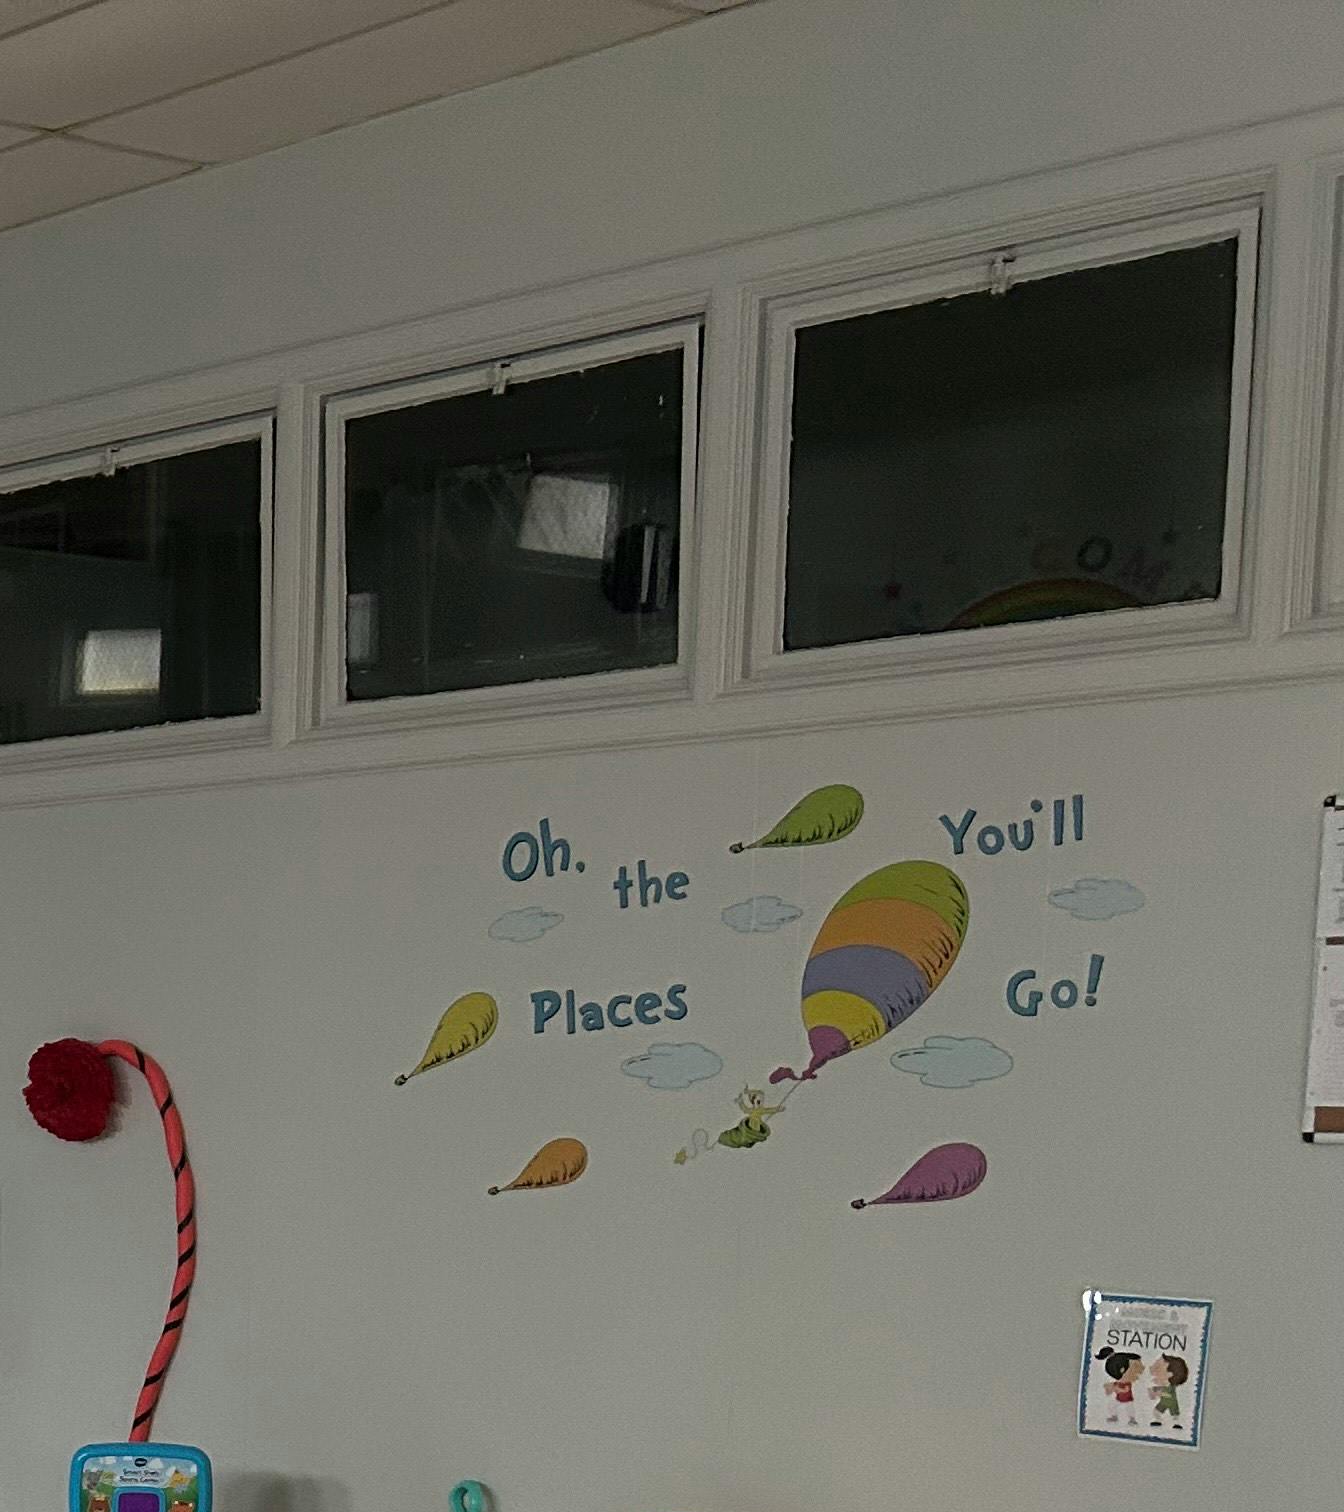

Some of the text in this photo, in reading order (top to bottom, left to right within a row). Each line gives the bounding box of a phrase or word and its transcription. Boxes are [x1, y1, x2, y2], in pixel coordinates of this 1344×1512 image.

[939, 794, 1085, 858] You'll
[614, 860, 690, 909] the
[530, 984, 689, 1035] Places
[1006, 954, 1105, 1018] Go!
[1106, 1329, 1188, 1351] STATION
